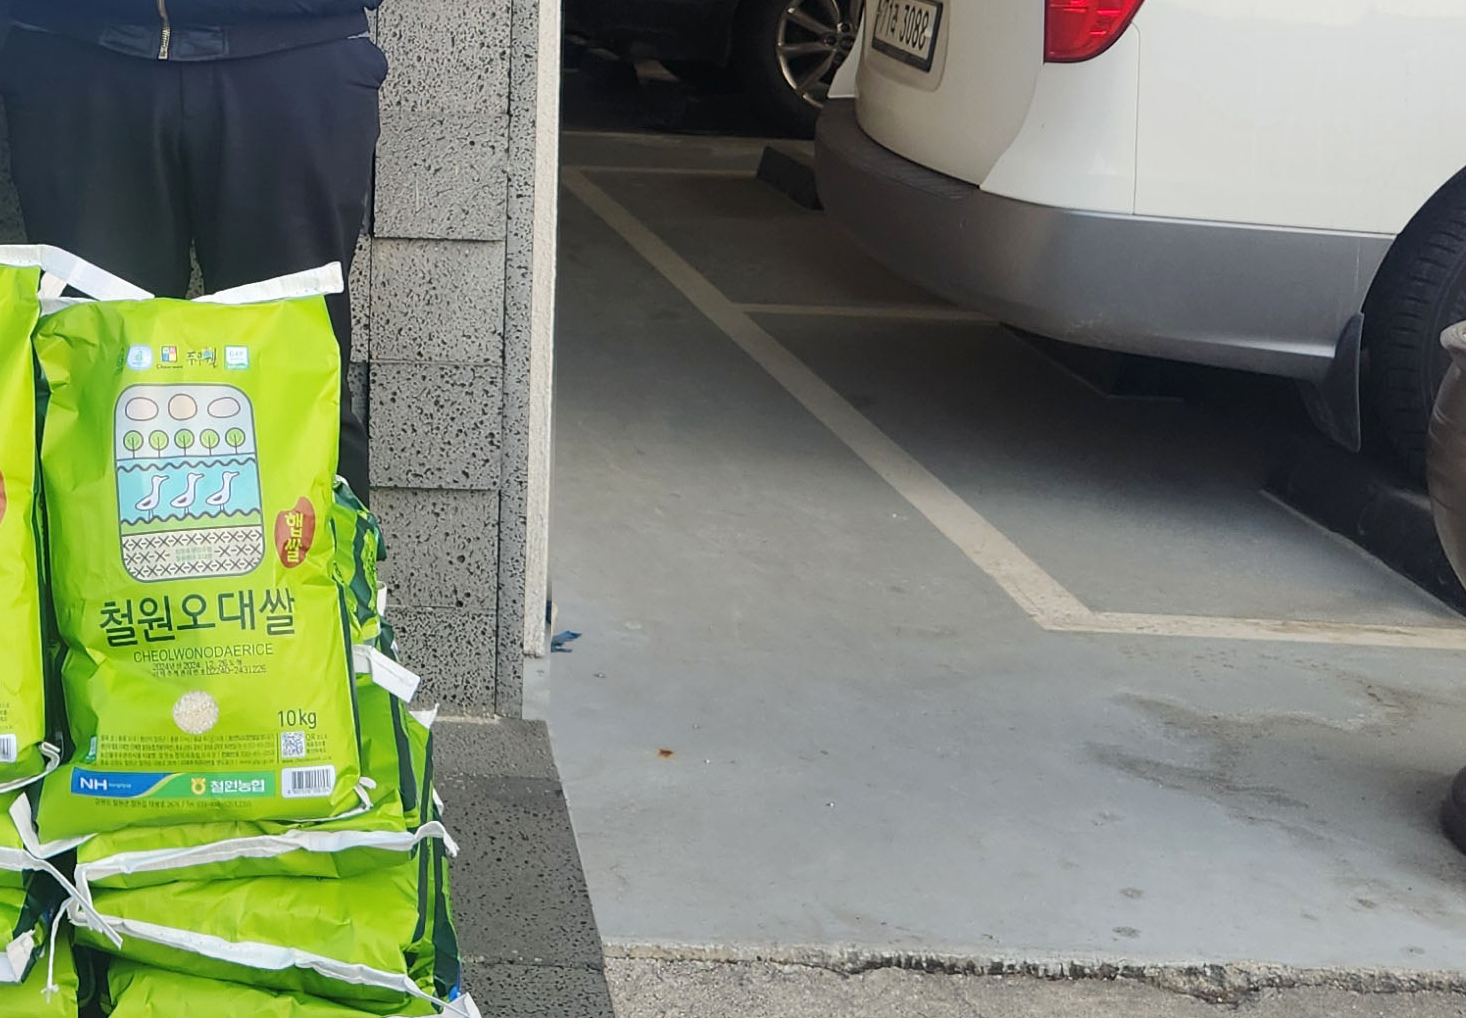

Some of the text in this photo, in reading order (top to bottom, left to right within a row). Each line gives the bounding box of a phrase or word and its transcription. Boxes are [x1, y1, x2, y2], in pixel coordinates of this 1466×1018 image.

[284, 511, 303, 563] 햅쌀
[99, 587, 296, 647] 철원오대쌀
[133, 642, 274, 663] CHEOLWONODAERICE
[277, 709, 318, 729] 10kg
[80, 777, 107, 790] NH
[210, 779, 265, 794] 철원농협
